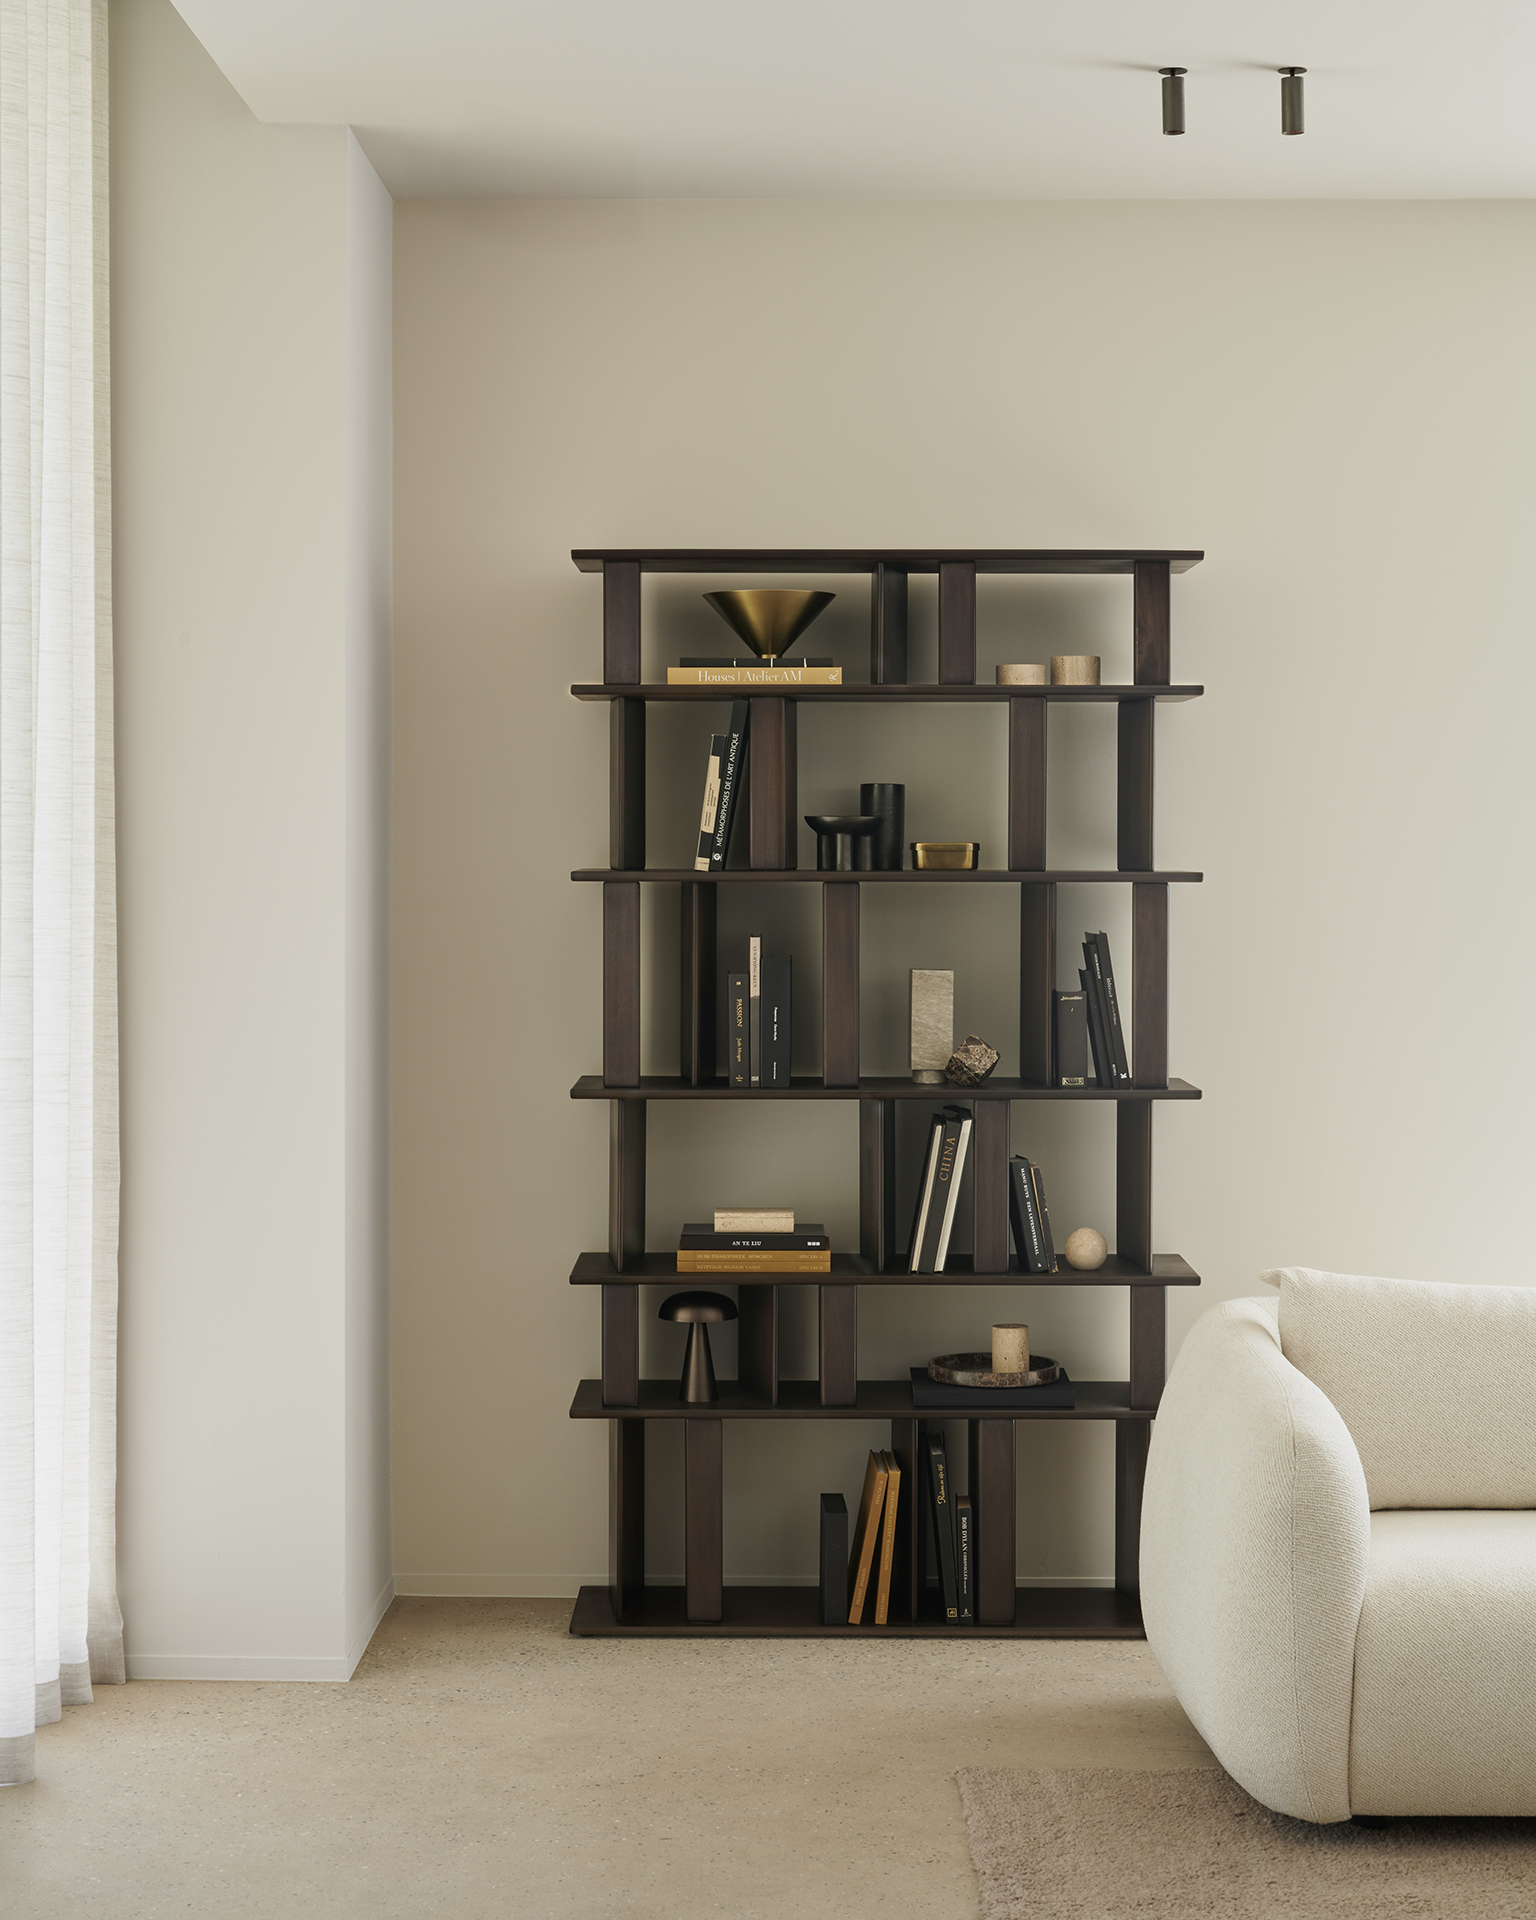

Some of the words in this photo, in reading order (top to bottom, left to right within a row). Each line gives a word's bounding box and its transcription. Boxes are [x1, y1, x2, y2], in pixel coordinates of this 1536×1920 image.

[698, 670, 735, 682] Houses
[743, 670, 780, 682] Atelier
[781, 670, 802, 682] AM
[729, 732, 739, 763] ANTIQUE
[725, 762, 735, 781] L'ART
[724, 780, 732, 790] DE
[715, 790, 731, 847] MÉTAMORPHOSES
[939, 1137, 956, 1181] CHINA
[1020, 1167, 1028, 1184] MANU
